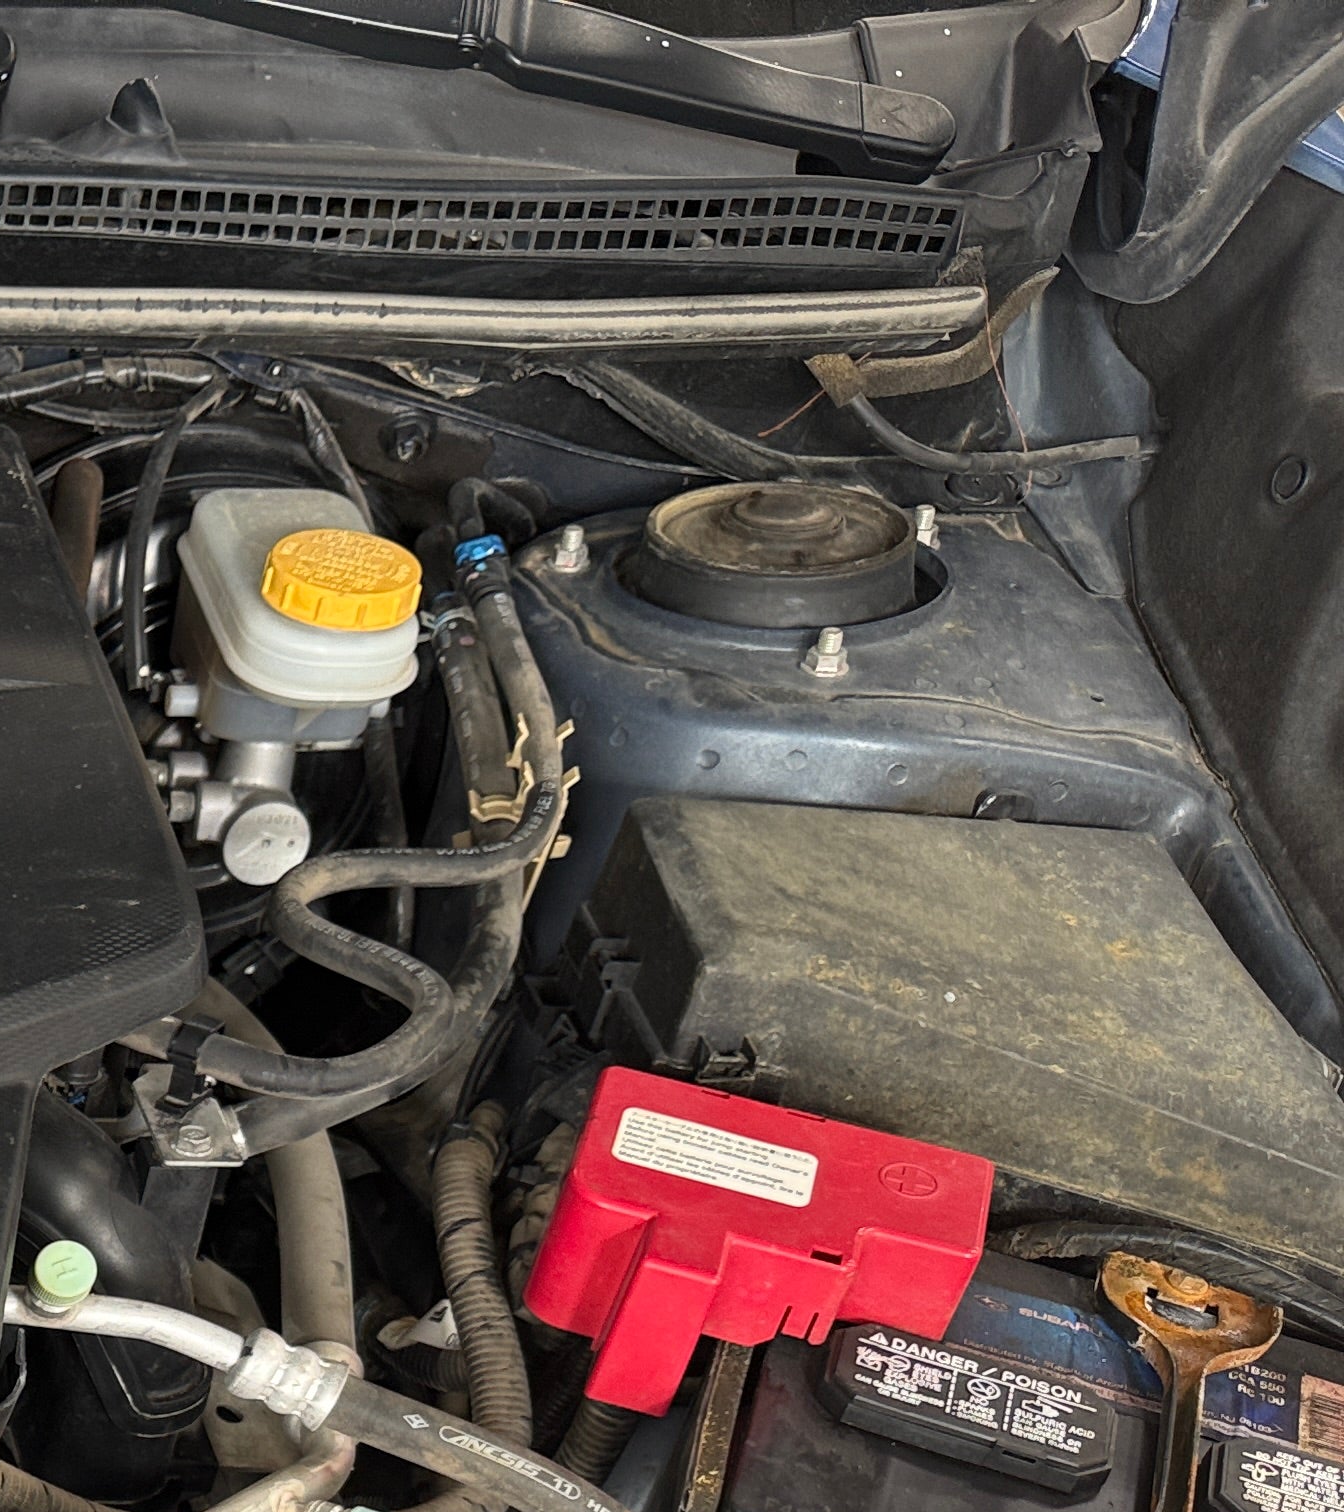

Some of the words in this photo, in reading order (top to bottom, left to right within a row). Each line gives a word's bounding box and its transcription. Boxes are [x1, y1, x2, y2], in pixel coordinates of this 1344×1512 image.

[891, 1337, 979, 1374] DANGER
[1001, 1370, 1082, 1404] POISON
[912, 1369, 940, 1384] EYES
[913, 1362, 952, 1381] SHIELD
[883, 1376, 918, 1393] GASES
[884, 1369, 942, 1393] EXPLOSIVE
[1228, 1371, 1256, 1388] CCA
[1259, 1382, 1286, 1394] 550
[969, 1395, 990, 1407] NO
[1237, 1384, 1255, 1398] RC
[1259, 1394, 1285, 1406] 100
[1068, 1425, 1096, 1440] ACID
[1303, 1459, 1323, 1470] OUT
[1325, 1465, 1340, 1473] OF
[1313, 1478, 1337, 1490] EYES
